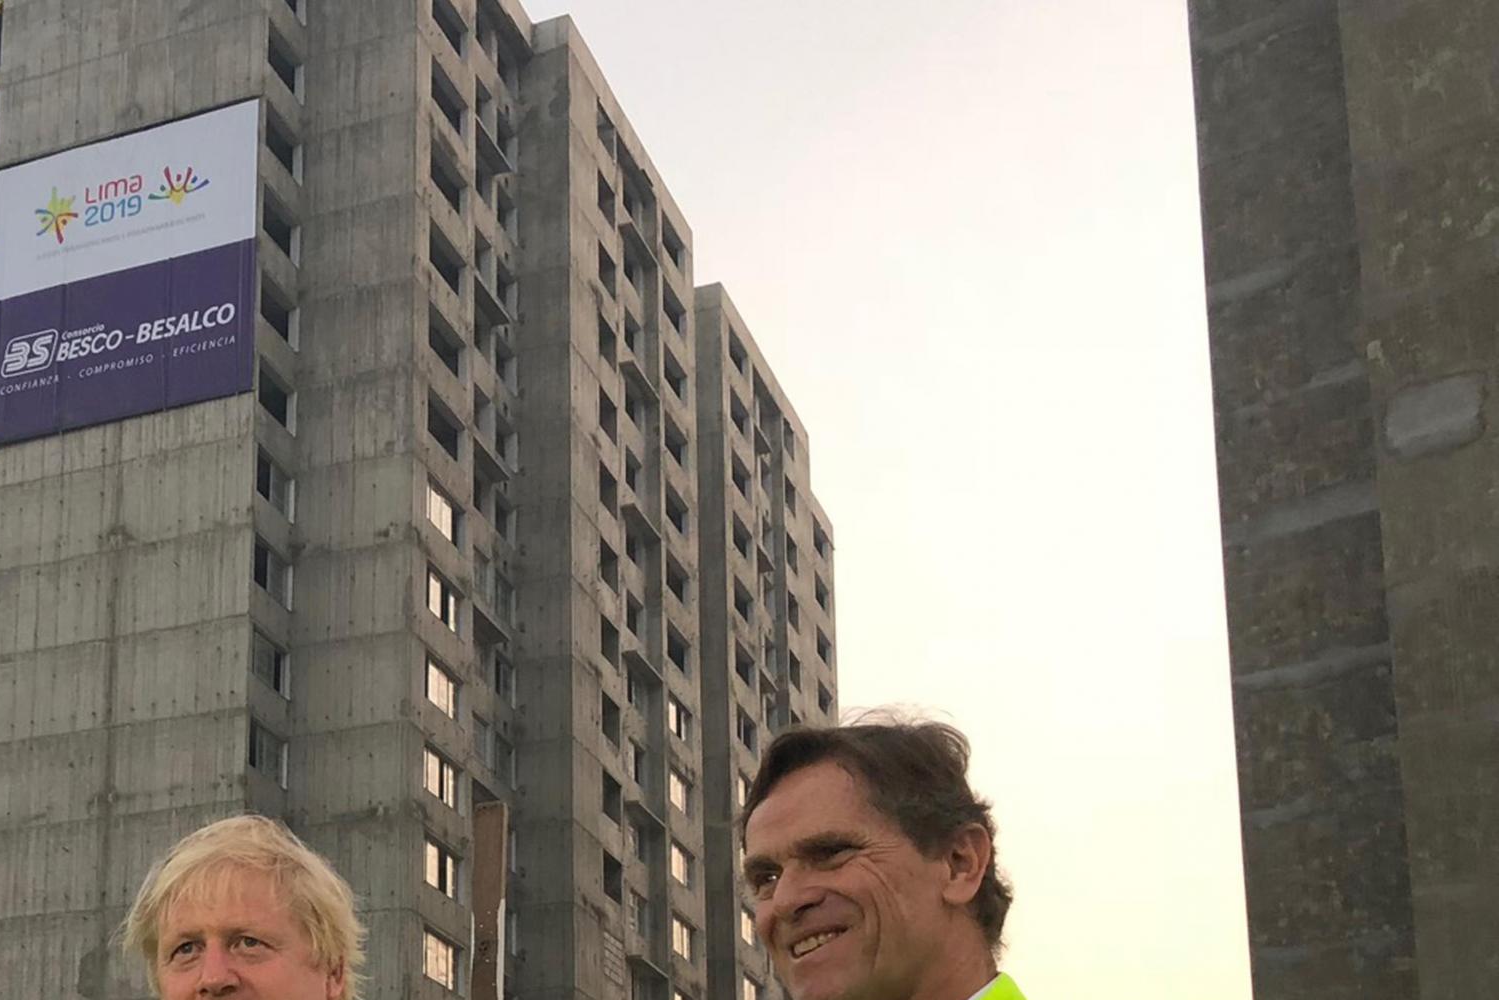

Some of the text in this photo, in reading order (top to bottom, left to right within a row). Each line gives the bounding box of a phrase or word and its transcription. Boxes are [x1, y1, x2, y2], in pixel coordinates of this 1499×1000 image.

[84, 195, 143, 226] 2019
[61, 323, 105, 340] Consorcio
[0, 335, 236, 395] CONFIANZA COMPROMISO EFICIENCIA
